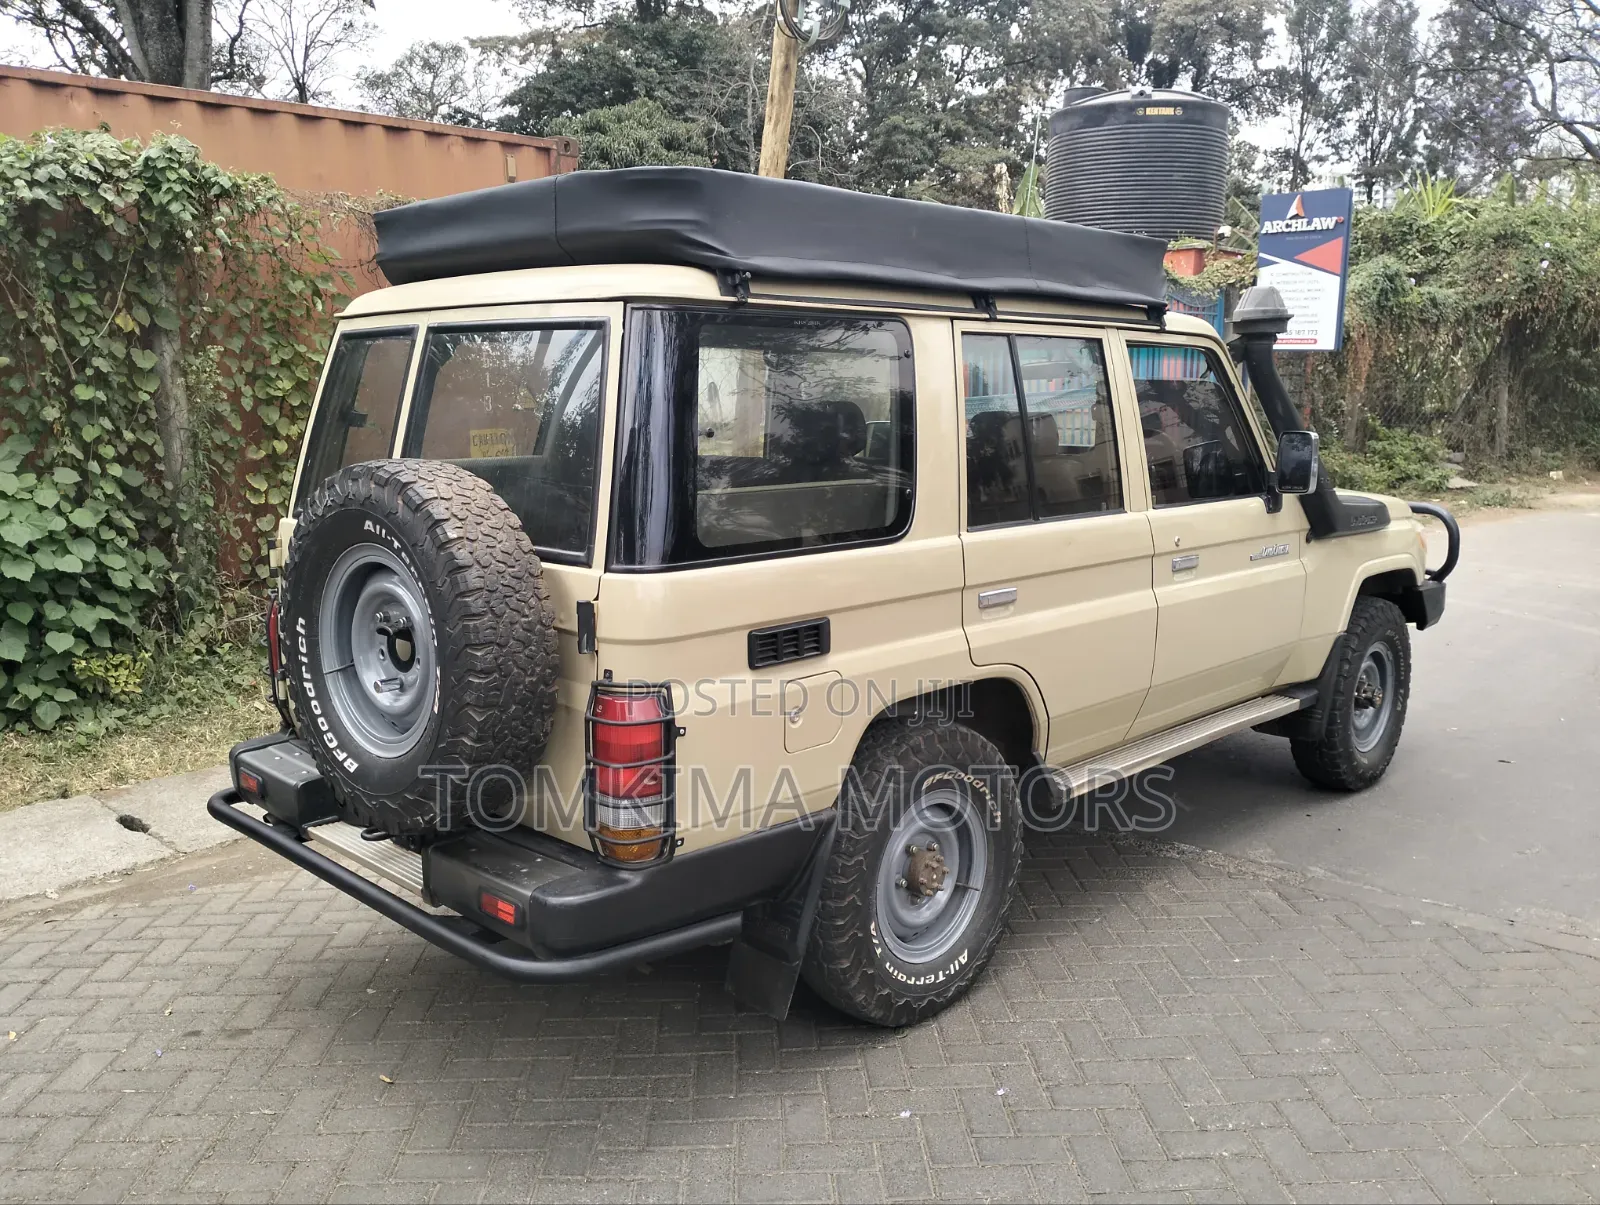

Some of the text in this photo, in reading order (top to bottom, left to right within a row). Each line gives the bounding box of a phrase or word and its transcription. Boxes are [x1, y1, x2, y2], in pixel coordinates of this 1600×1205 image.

[1261, 216, 1338, 234] ARCHLAW
[363, 518, 438, 647] All-Terrain
[296, 616, 359, 774] BFGoodrich
[922, 769, 1002, 823] BFGoodrich
[885, 948, 968, 986] All-Terrain
